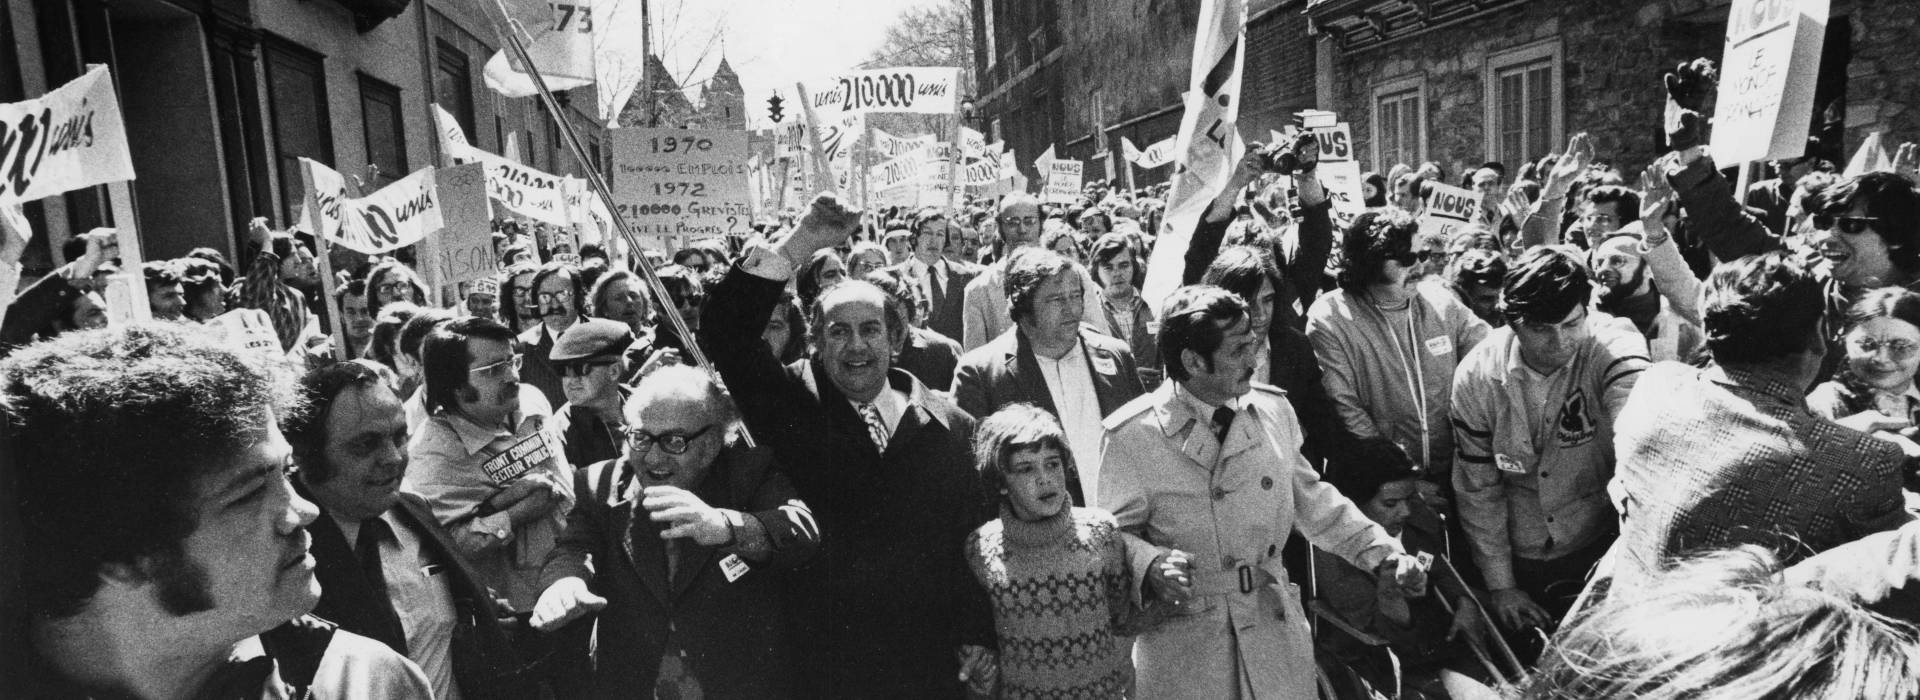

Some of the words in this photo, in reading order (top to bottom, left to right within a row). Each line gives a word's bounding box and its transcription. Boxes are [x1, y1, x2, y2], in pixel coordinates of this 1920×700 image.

[814, 86, 843, 108] unis
[918, 78, 949, 97] unis
[651, 136, 713, 154] 1970
[677, 161, 746, 175] EMPLOIS
[1052, 163, 1081, 173] NOUS
[654, 182, 708, 197] 1972
[396, 185, 434, 223] unis
[1432, 191, 1476, 218] NOUS
[483, 452, 510, 475] FRONT
